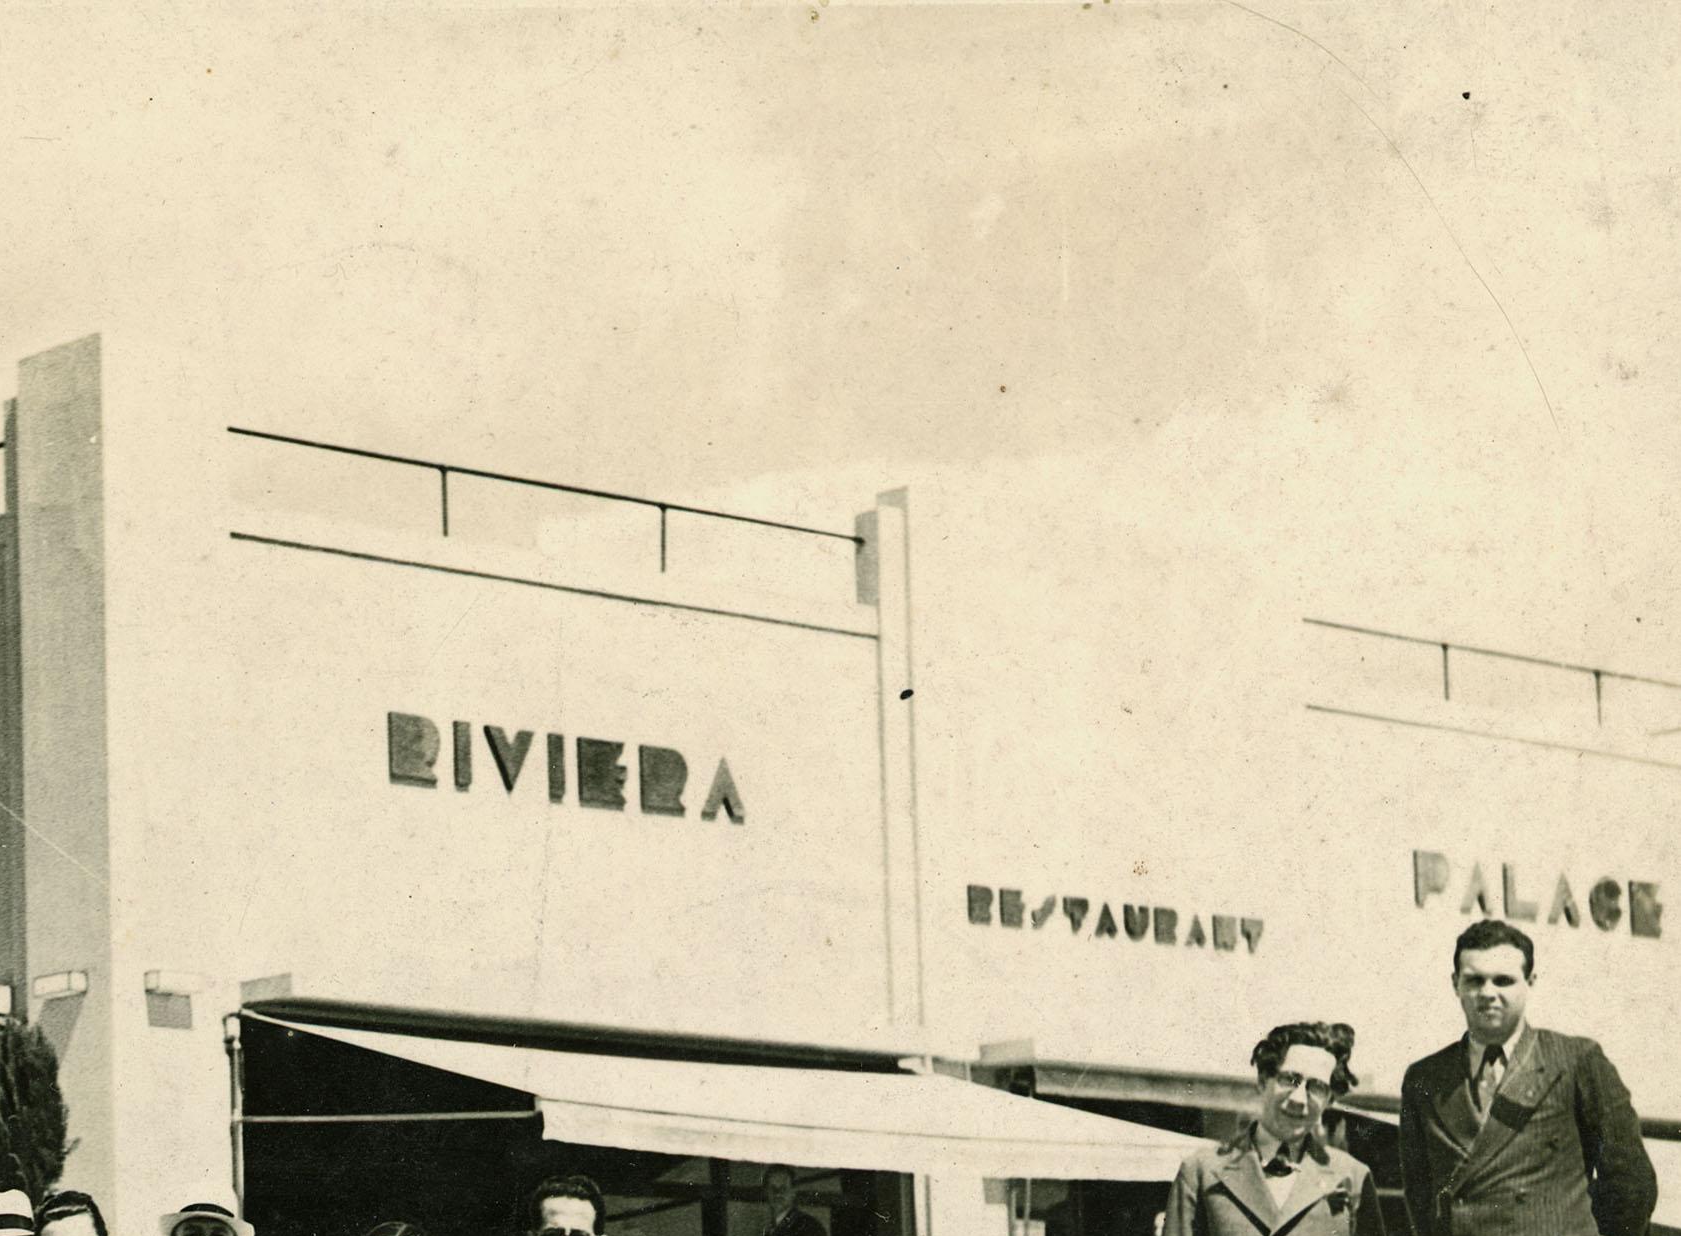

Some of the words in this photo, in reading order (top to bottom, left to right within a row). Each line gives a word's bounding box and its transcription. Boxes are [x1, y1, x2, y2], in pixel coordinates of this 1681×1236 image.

[387, 711, 746, 825] RIVIERA
[966, 884, 1265, 953] RESTAURANT
[1412, 849, 1664, 938] PALACE
